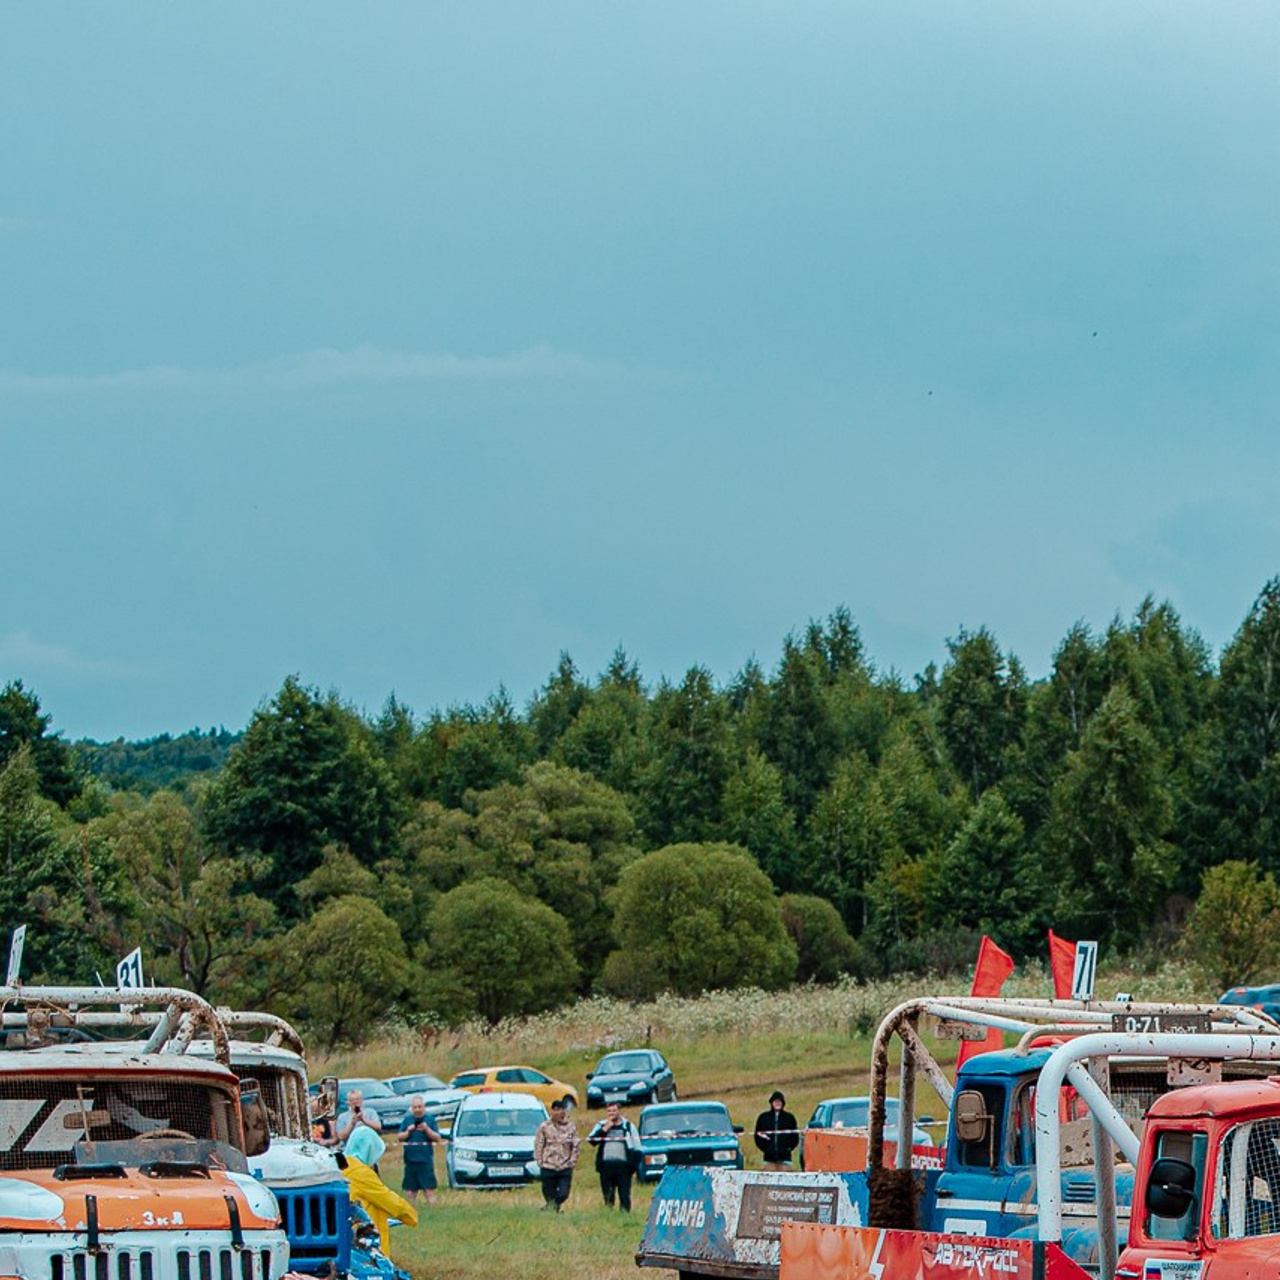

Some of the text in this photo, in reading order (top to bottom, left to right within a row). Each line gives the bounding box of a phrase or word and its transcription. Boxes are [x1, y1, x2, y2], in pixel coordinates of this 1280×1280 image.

[1075, 945, 1096, 995] 71
[656, 1199, 706, 1228] РЯЗАНЬ
[934, 1243, 1019, 1277] АВТОКРОСС
